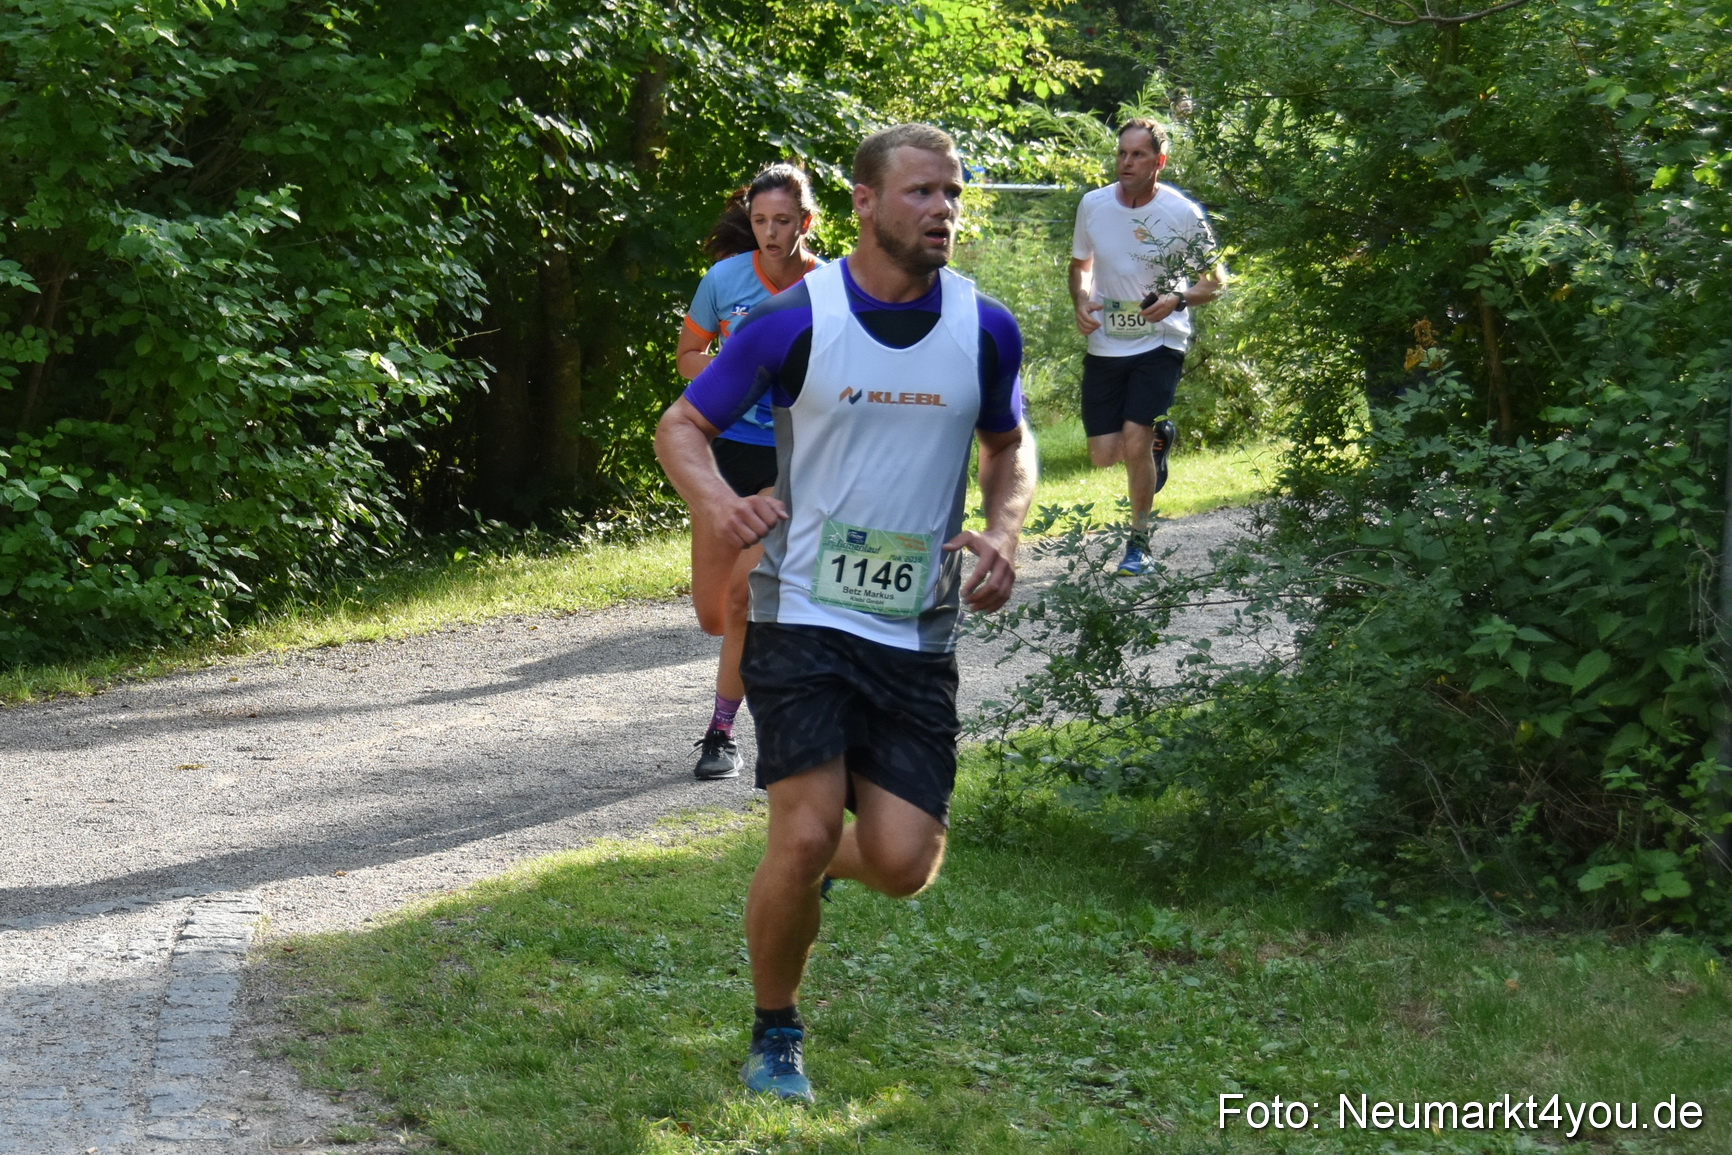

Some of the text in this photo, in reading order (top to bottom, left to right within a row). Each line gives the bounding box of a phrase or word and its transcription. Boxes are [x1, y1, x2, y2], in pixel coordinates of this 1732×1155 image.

[1109, 313, 1146, 327] 1350
[867, 391, 947, 407] KLEBL
[831, 554, 913, 593] 1146
[842, 586, 895, 600] Betz Markus
